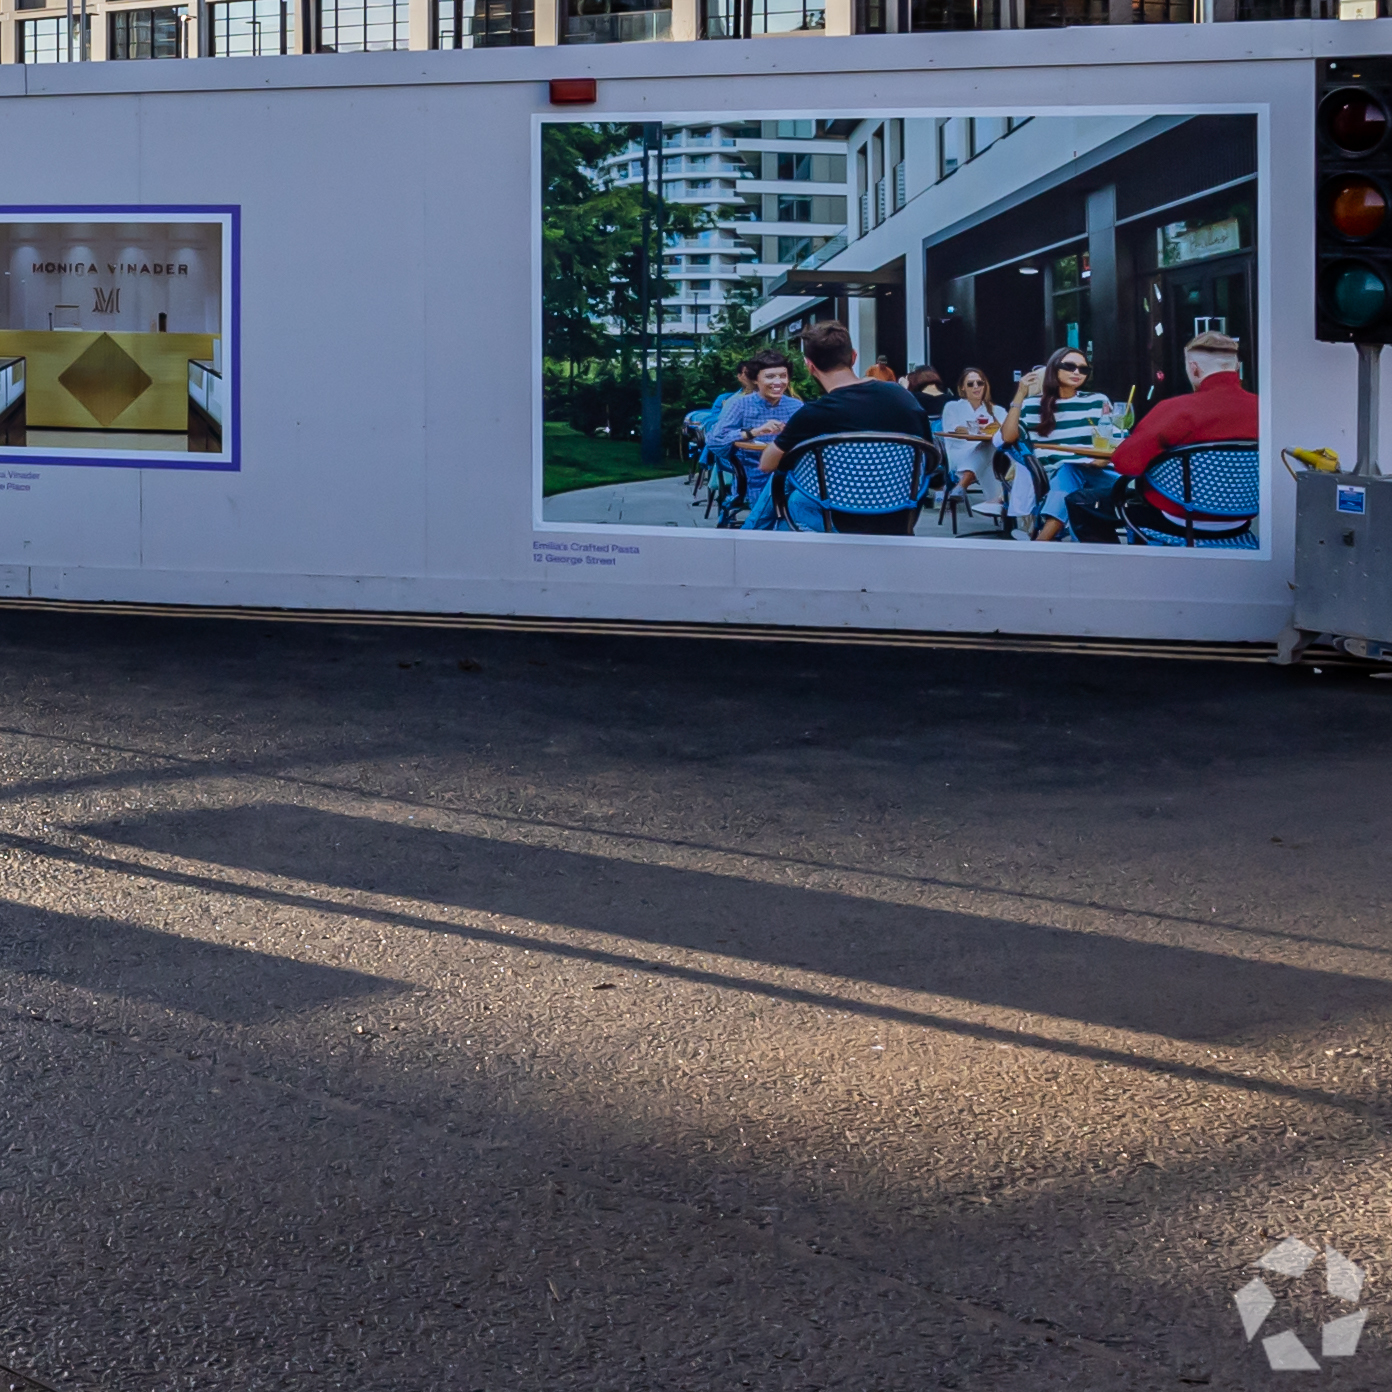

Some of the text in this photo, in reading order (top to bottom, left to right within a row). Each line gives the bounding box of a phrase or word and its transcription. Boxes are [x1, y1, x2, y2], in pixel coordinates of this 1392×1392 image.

[32, 262, 189, 275] MONICA VINADER
[8, 470, 40, 479] Vinader
[7, 482, 31, 491] Place
[533, 540, 640, 554] Emilia's Crafted Pasta
[533, 553, 616, 566] 12 George Street
